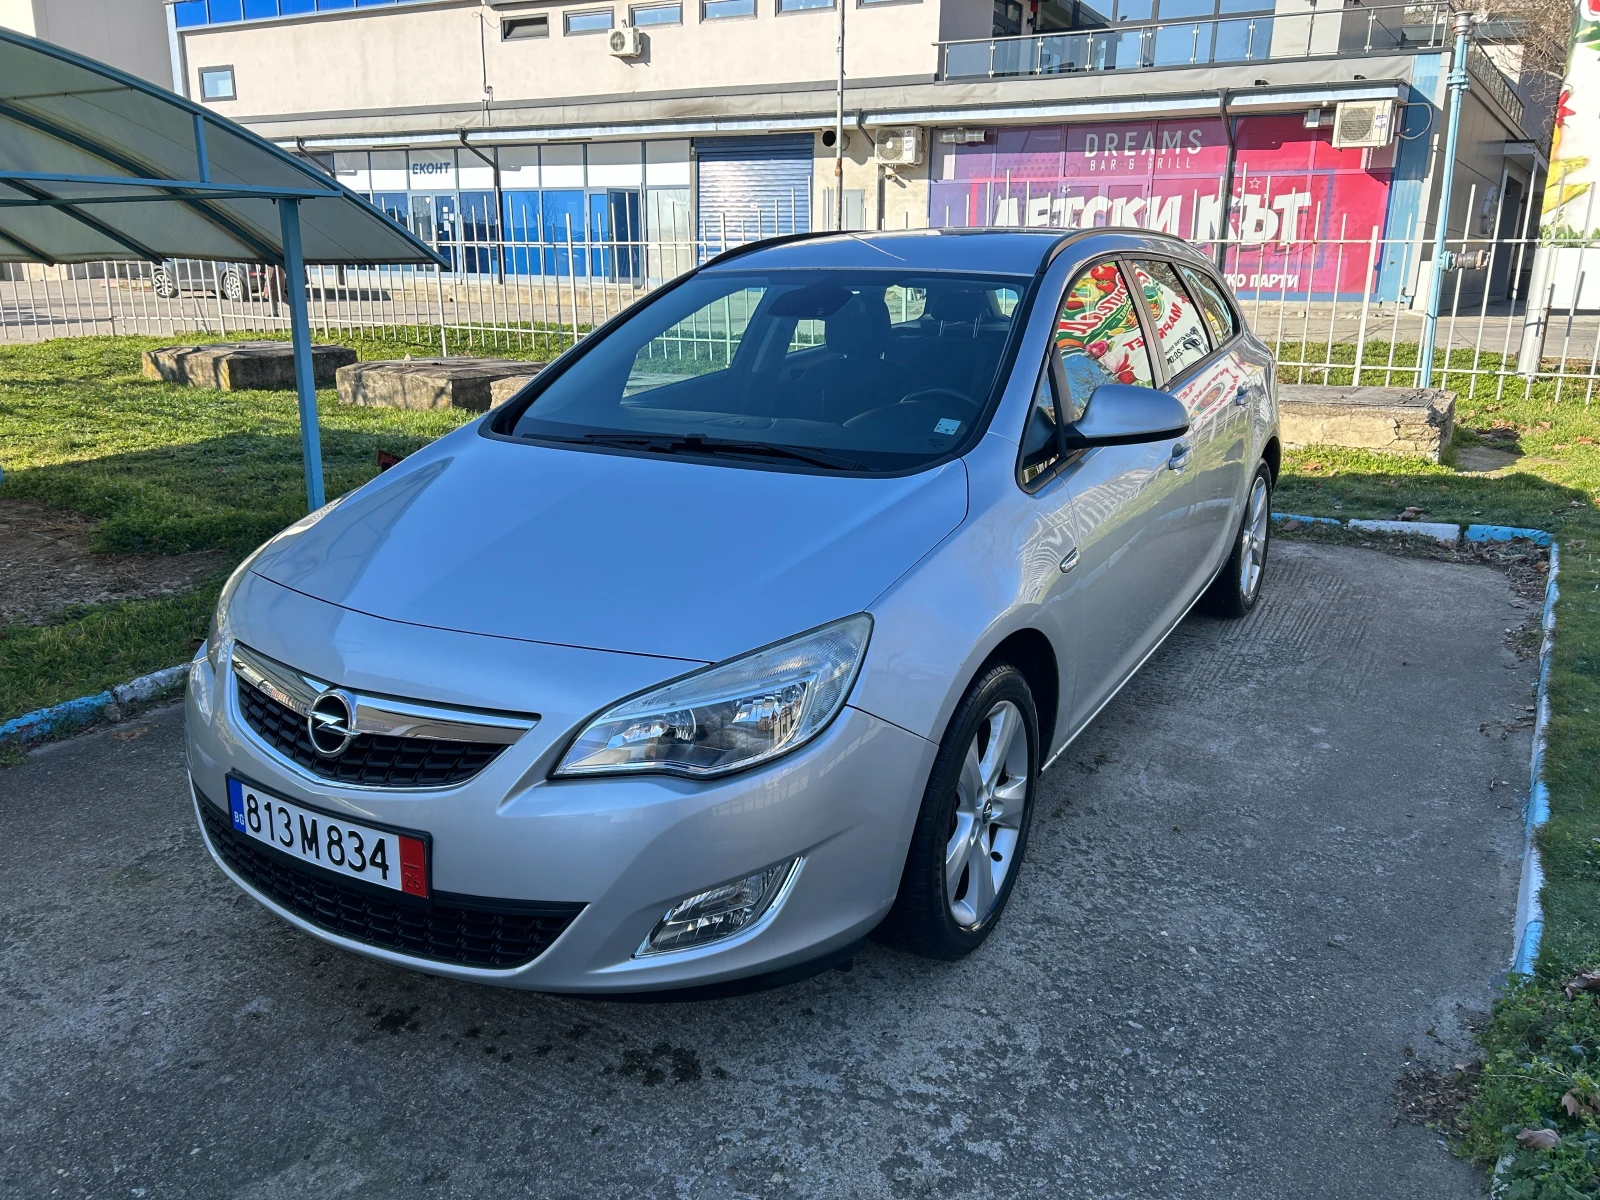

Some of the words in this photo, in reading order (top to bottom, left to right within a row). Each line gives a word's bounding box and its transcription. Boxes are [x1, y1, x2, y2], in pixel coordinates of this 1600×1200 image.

[1085, 129, 1202, 157] DREAMS
[412, 162, 451, 175] ЕКОНТ
[1090, 160, 1116, 171] BAR
[1128, 158, 1135, 169] &
[1148, 157, 1191, 169] GRILL
[1196, 192, 1311, 246] КЪТ
[1223, 273, 1247, 288] КО
[1249, 273, 1299, 288] ПАРТИ
[234, 811, 244, 825] BG
[406, 872, 420, 888] 26
